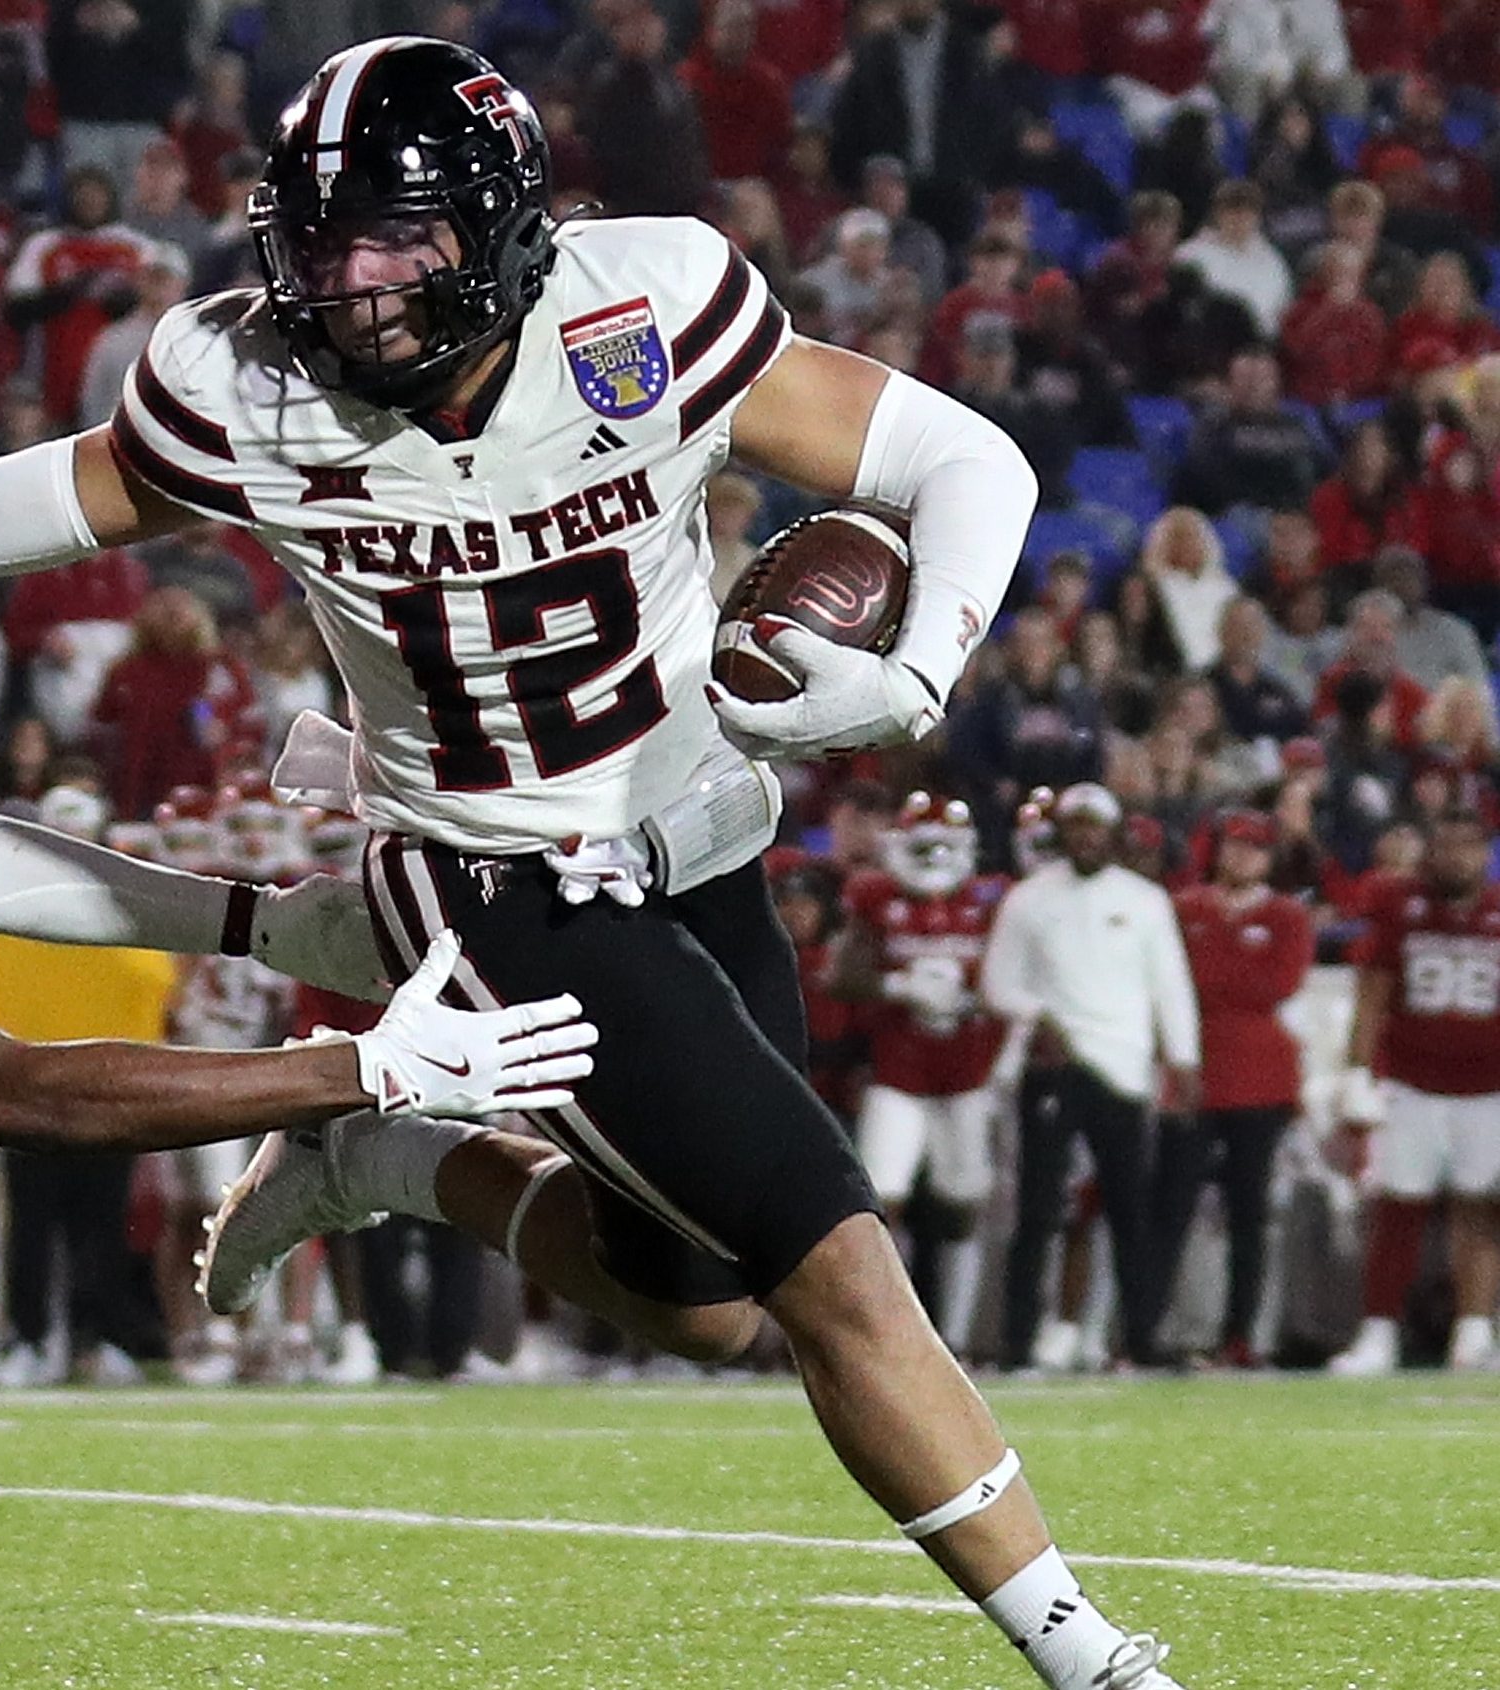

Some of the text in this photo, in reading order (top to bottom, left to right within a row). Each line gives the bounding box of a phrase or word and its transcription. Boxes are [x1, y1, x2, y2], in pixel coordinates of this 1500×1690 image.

[578, 327, 650, 362] LIBERTY
[590, 345, 649, 379] BOWL
[302, 468, 662, 575] TEXAS TECH
[376, 546, 672, 792] 12
